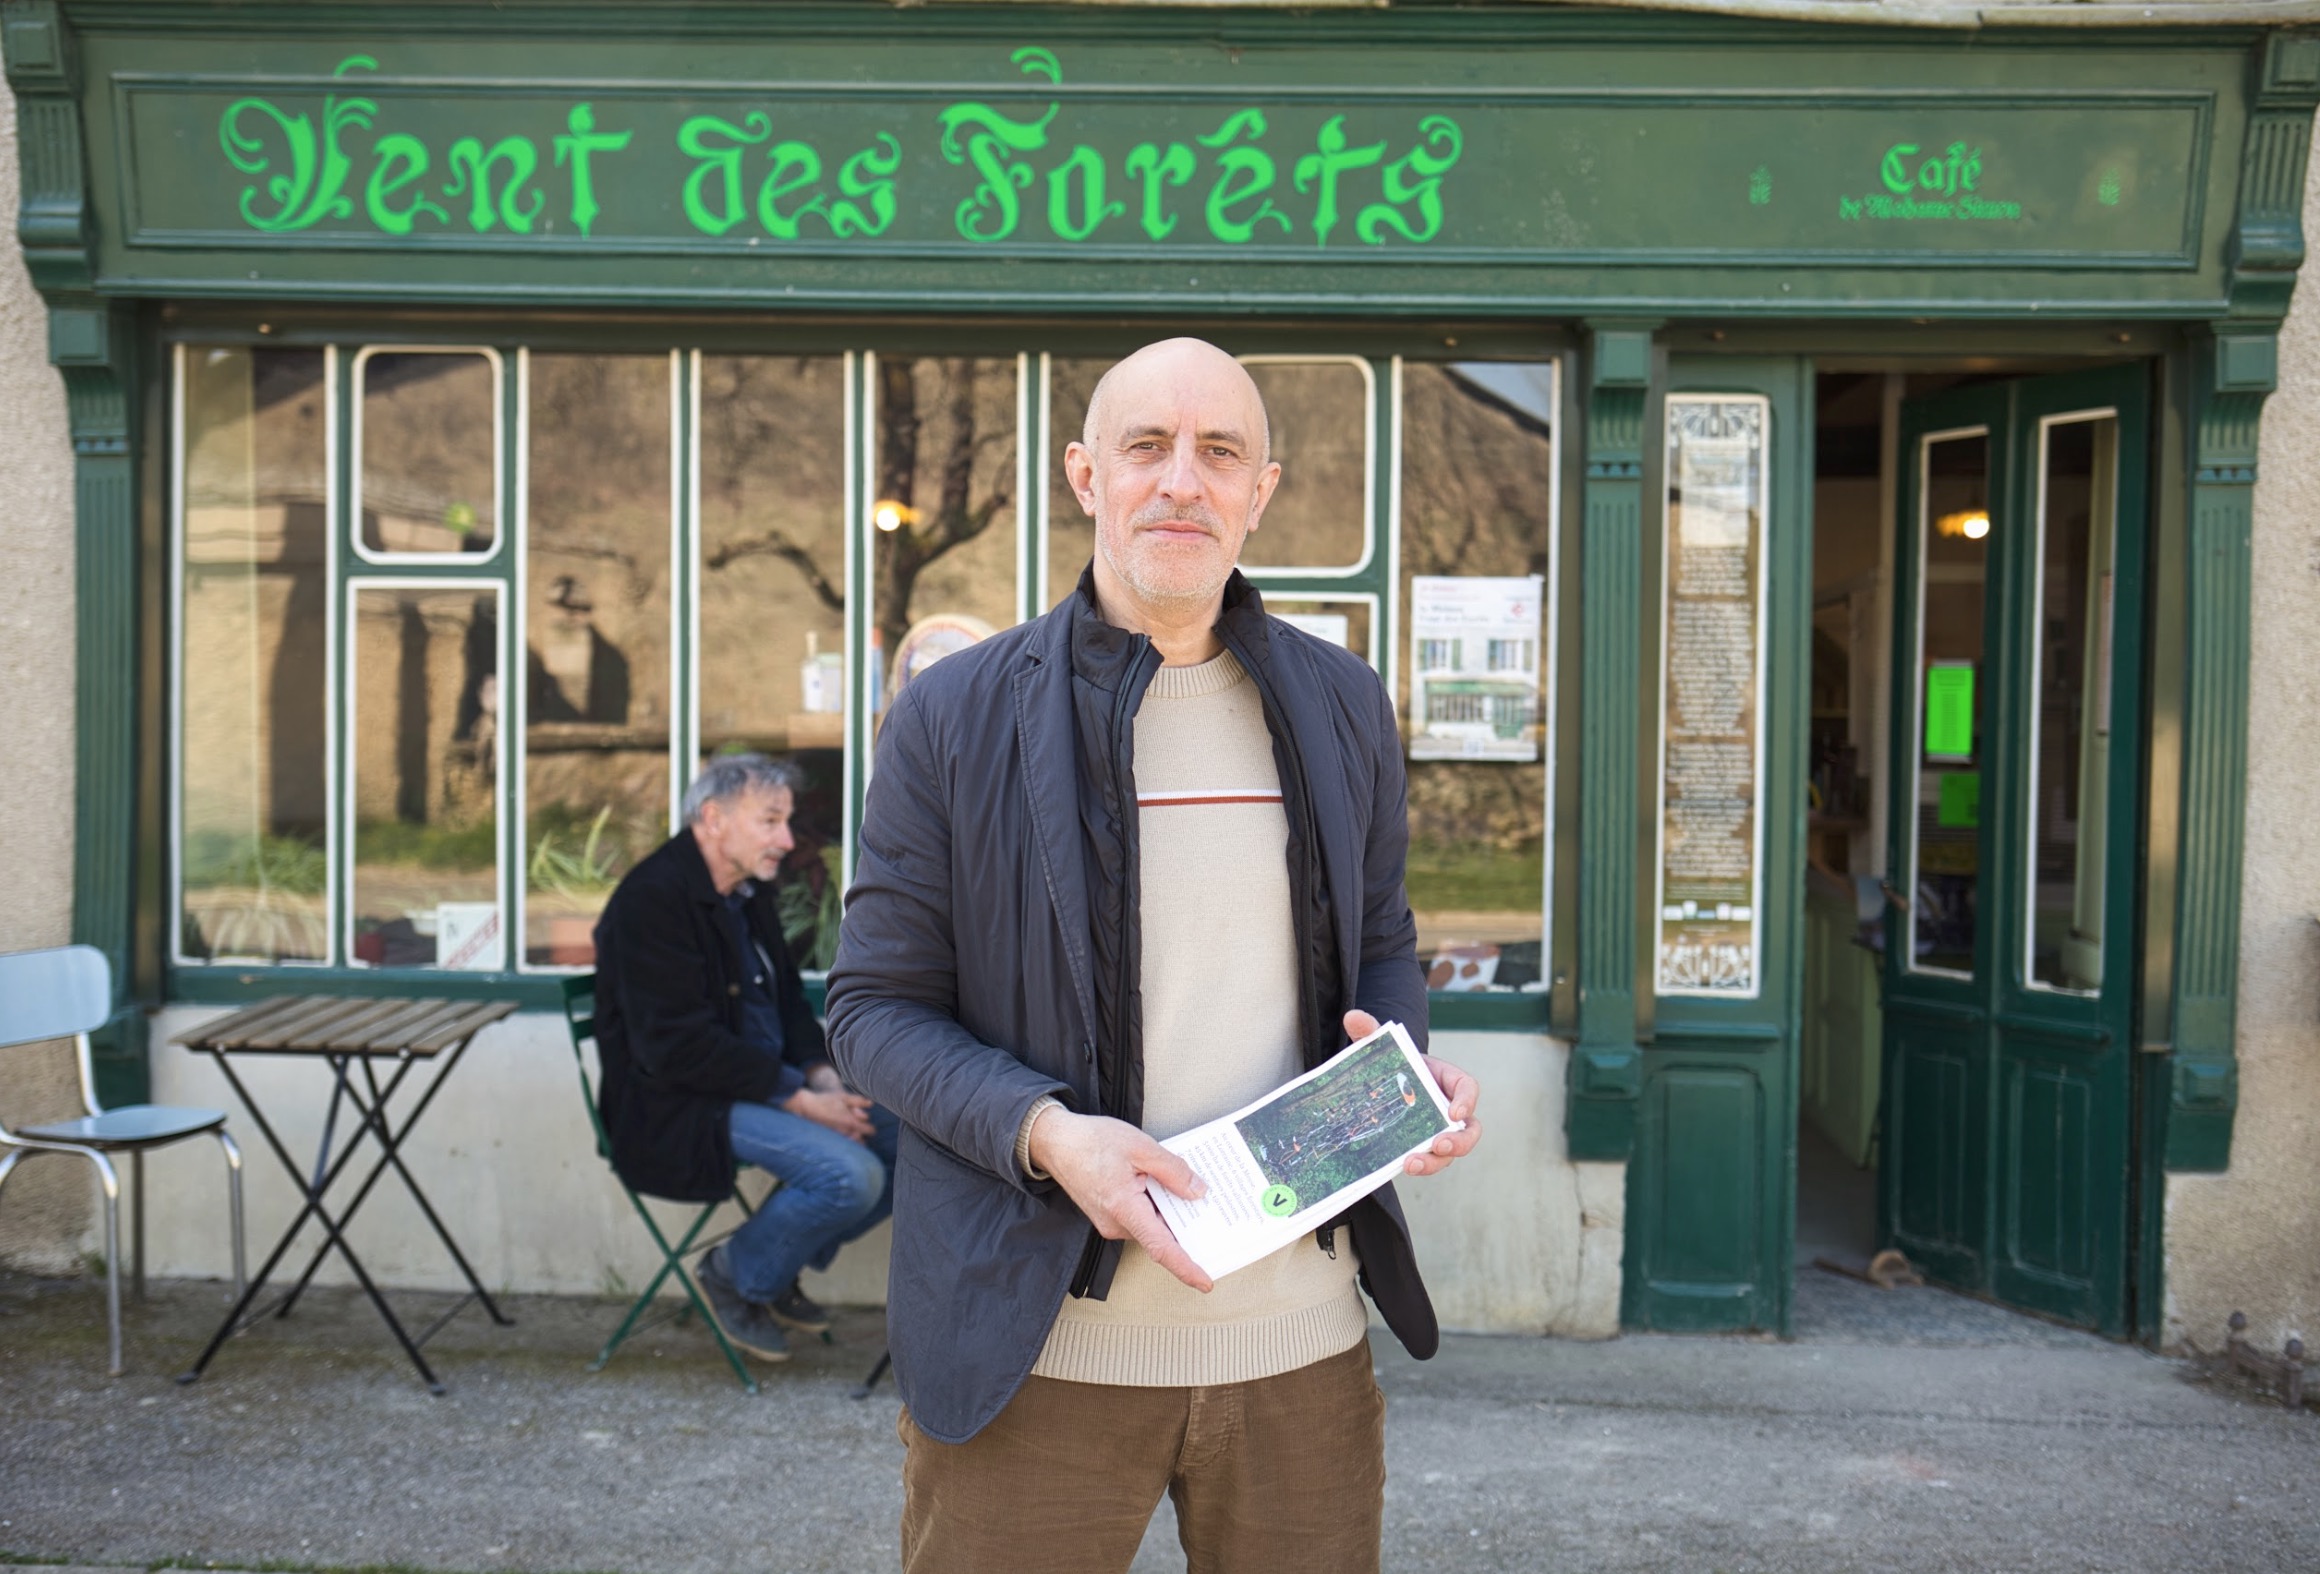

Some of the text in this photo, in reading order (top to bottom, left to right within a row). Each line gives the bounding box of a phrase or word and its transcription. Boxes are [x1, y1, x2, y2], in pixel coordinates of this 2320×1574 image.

[219, 47, 1463, 246] Vent des Forêts
[1881, 141, 1982, 197] Café
[1272, 1192, 1288, 1207] V
